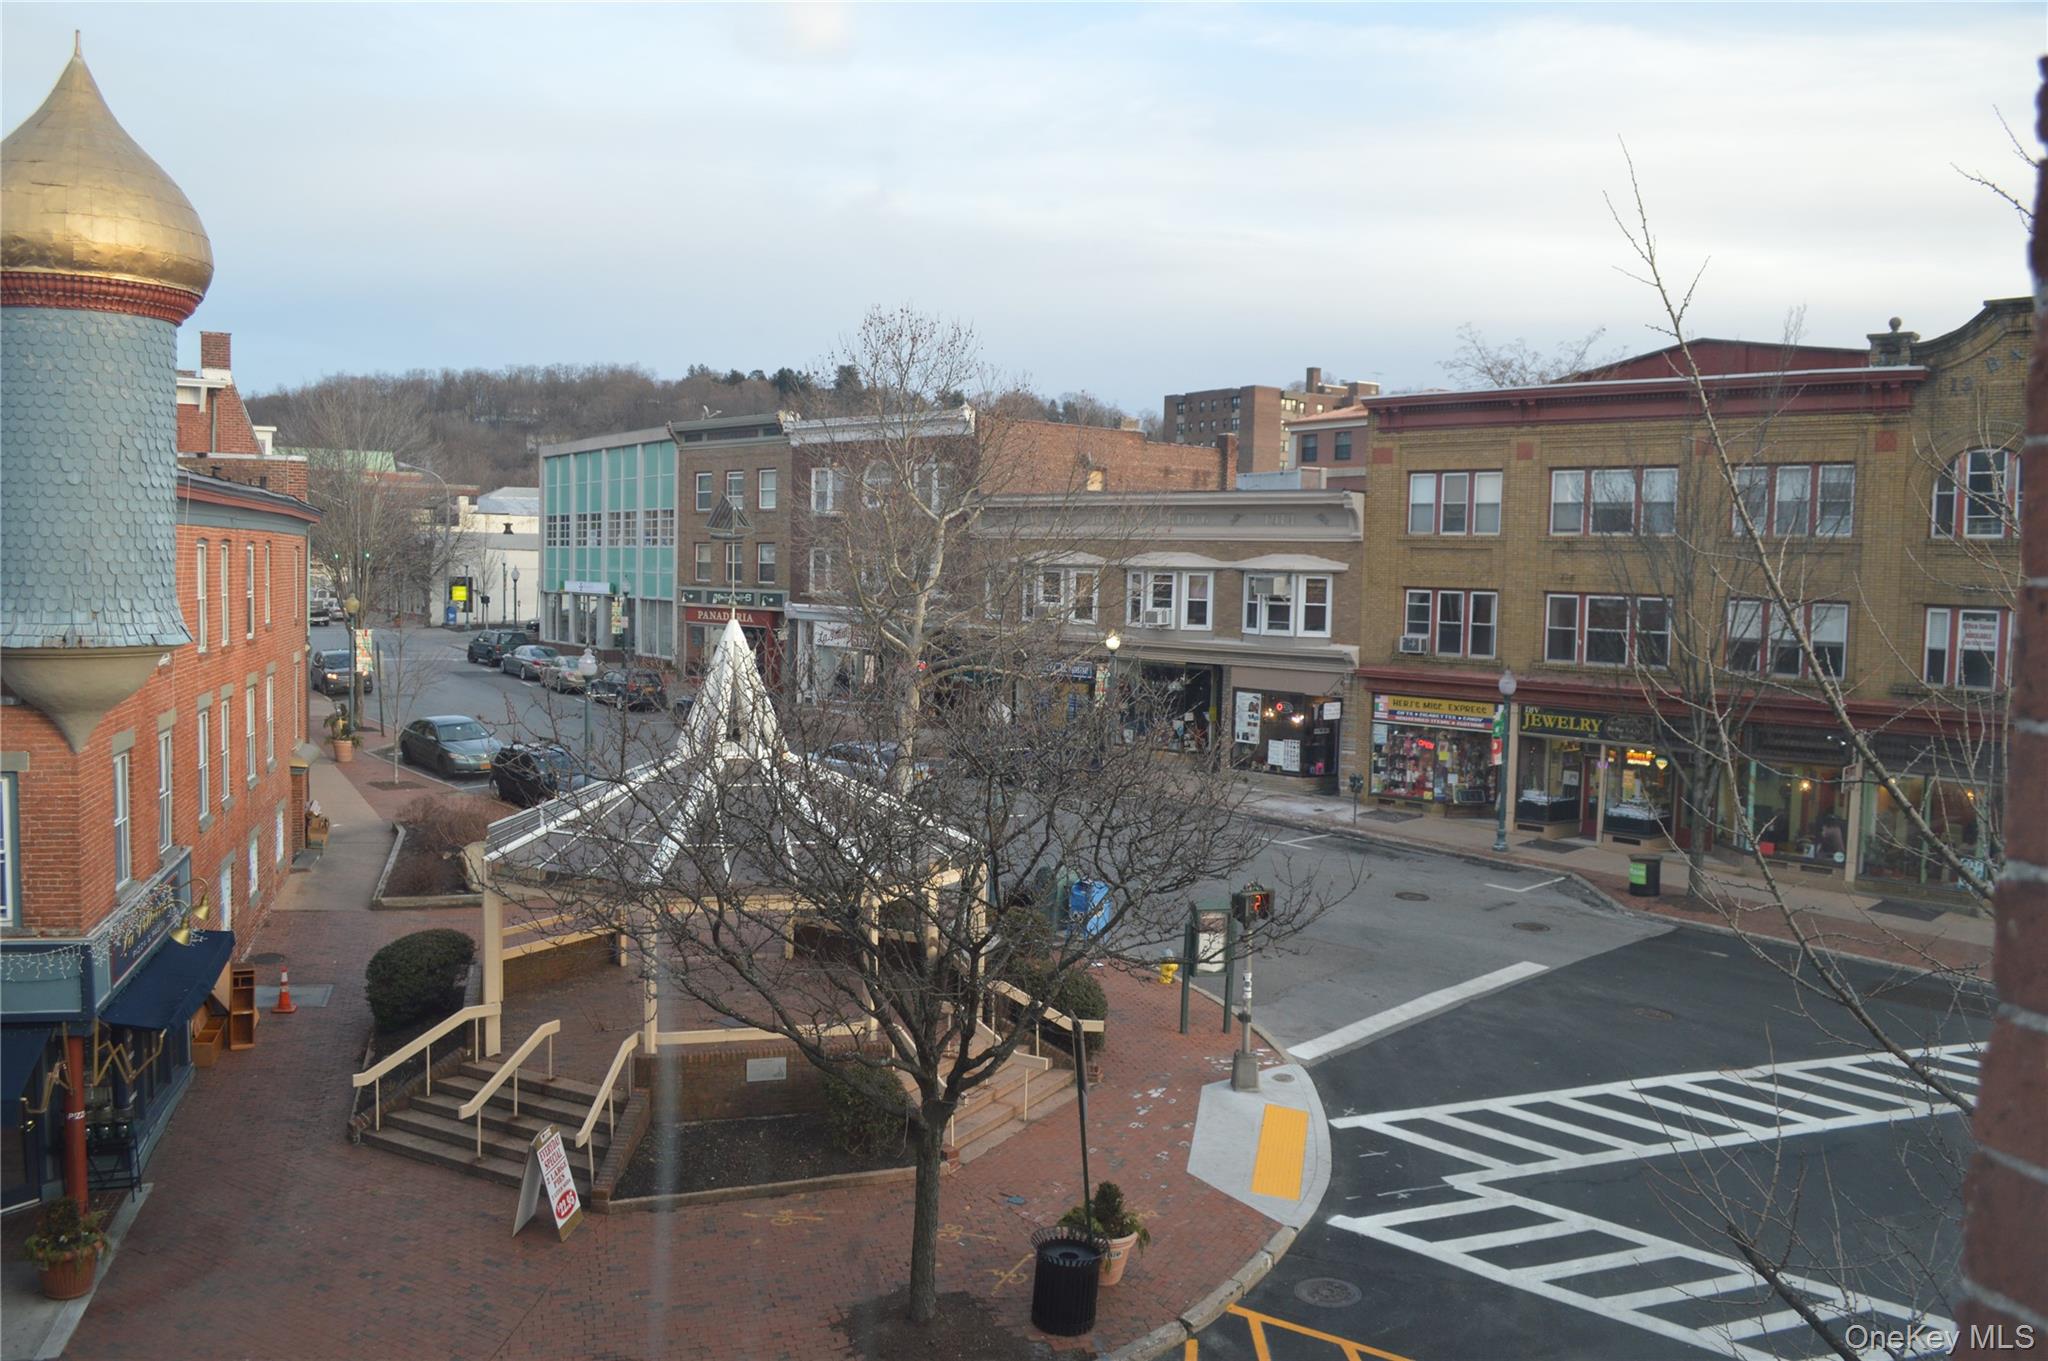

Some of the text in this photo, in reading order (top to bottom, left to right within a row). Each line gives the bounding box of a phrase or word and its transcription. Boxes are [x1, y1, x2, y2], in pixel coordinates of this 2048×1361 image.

[697, 610, 754, 623] PANADRIA
[1448, 702, 1488, 714] EXPRESS
[1522, 713, 1603, 733] JEWELRY
[1417, 738, 1435, 751] OPEN
[544, 1148, 563, 1171] SPECIAL
[550, 1160, 567, 1181] LARGE
[552, 1174, 566, 1189] PIES
